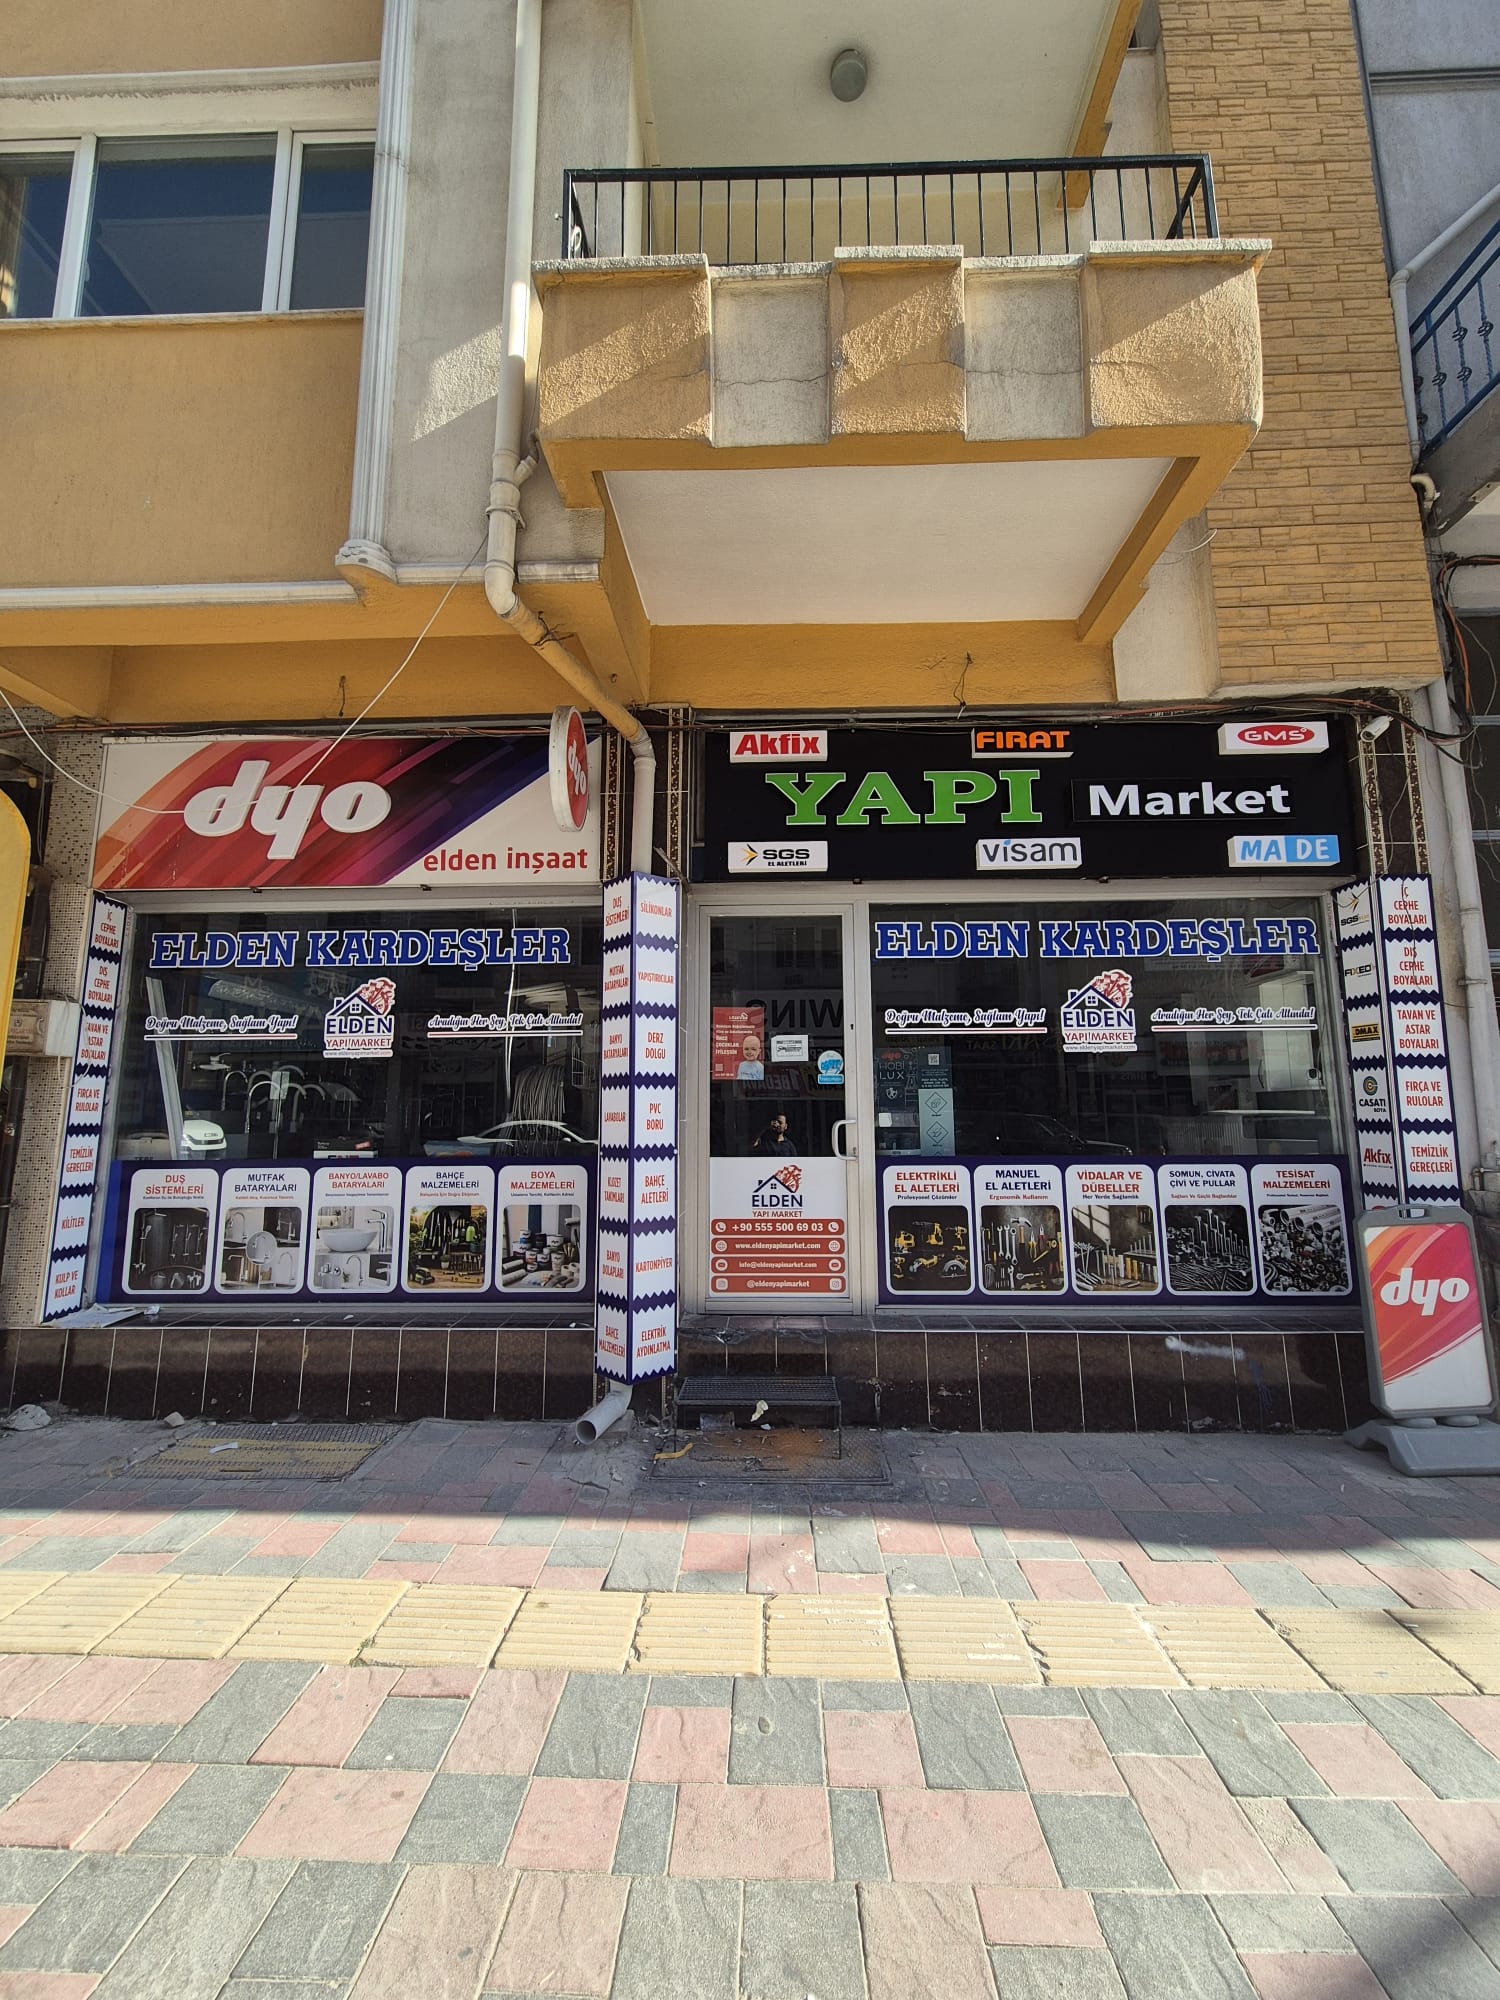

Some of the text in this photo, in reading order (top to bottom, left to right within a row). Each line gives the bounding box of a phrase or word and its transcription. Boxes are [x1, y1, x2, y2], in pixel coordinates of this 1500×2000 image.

[976, 730, 1071, 749] FIRAT
[1243, 729, 1306, 741] GMS
[734, 733, 821, 756] Akfix
[568, 740, 587, 795] dyo
[765, 769, 1291, 826] YAPI Market
[183, 759, 392, 860] dyo
[763, 849, 810, 860] SGS
[982, 839, 1078, 865] visam
[423, 847, 588, 874] elden inşaat
[640, 901, 672, 918] SİLİKONLAR
[1393, 901, 1419, 911] CEPHE
[605, 906, 630, 927] SİSTEMLERİ
[1340, 914, 1359, 926] SGS
[1387, 914, 1427, 925] BOYALARI
[100, 922, 116, 935] CEPHE
[94, 933, 119, 949] BOYALARI
[875, 917, 1320, 962] ELDEN KARDEŞLER
[150, 927, 571, 971] ELDEN KARDEŞLER
[1404, 946, 1417, 958] DIŞ
[99, 965, 109, 977] DIŞ
[1399, 960, 1425, 971] CEPHE
[94, 978, 111, 990] CEPHE
[637, 971, 674, 985] YAPIŞTIRICILAR
[1393, 974, 1433, 986] BOYALARI
[88, 990, 112, 1003] BOYALARI
[885, 1009, 920, 1028] Doğru
[973, 1008, 1014, 1027] Sağlam
[1014, 1008, 1046, 1027] Yapı!
[1063, 1010, 1133, 1027] ELDEN
[1151, 1006, 1317, 1025] Aradığın Her Şey, Tek Çatı Altında!
[1397, 1009, 1436, 1020] TAVAN VE
[145, 1016, 178, 1033] Doğru
[229, 1015, 267, 1033] Sağlam
[267, 1014, 299, 1033] Yapı!
[326, 1017, 392, 1034] ELDEN
[428, 1013, 583, 1031] Aradığın Her Şey, Tek Çatı Altında!
[87, 1023, 109, 1034] AVAN VE
[1355, 1025, 1379, 1036] DMAX
[1405, 1023, 1431, 1035] ASTAR
[647, 1032, 664, 1044] DERZ
[1065, 1032, 1133, 1040] YAPI MARKET
[326, 1038, 391, 1047] YAPI MARKET
[1399, 1038, 1439, 1049] BOYALARI
[645, 1047, 666, 1060] DOLGU
[879, 1071, 905, 1080] LUX
[1405, 1081, 1442, 1094] FIRÇA VE
[77, 1088, 100, 1100] FIRÇA VE
[75, 1102, 99, 1112] RULOLAR
[1358, 1098, 1386, 1107] CASATI
[1406, 1095, 1444, 1107] RULOLAR
[649, 1103, 661, 1115] PVC
[646, 1119, 664, 1130] BORU
[70, 1147, 93, 1159] TEMİZLİK
[1363, 1148, 1392, 1165] Akfix
[1411, 1144, 1449, 1158] TEMİZLİK
[66, 1159, 94, 1173] GEREÇLERİ
[1409, 1159, 1453, 1174] GEREÇLERİ
[165, 1174, 186, 1185] DUŞ
[247, 1174, 285, 1182] MUTFAK
[328, 1172, 389, 1180] BANYO/LAVABO
[436, 1172, 465, 1180] BAHÇE
[896, 1170, 957, 1180] ELEKTRİKLİ
[995, 1170, 1040, 1178] MANUEL
[1077, 1170, 1143, 1180] VİDALAR VE
[1206, 1169, 1236, 1178] CİVATA
[1276, 1169, 1315, 1178] TESİSAT
[234, 1184, 297, 1192] BATARYALARI
[420, 1180, 480, 1188] MALZEMELERİ
[510, 1180, 575, 1189] MALZEMELERİ
[645, 1175, 665, 1189] BAHÇE
[894, 1182, 960, 1192] EL ALETLERİ
[986, 1180, 1051, 1190] EL ALETLERİ
[1082, 1182, 1140, 1192] DÜBELLER
[1170, 1179, 1186, 1188] ÇİVİ
[1263, 1179, 1330, 1188] MALZEMELERİ
[145, 1184, 204, 1195] SİSTEMLERİ
[641, 1188, 669, 1205] ALETLERİ
[752, 1194, 803, 1207] ELDEN
[61, 1214, 85, 1230] KİLİTLER
[732, 1223, 823, 1231] +90 555 500 69 03
[635, 1256, 673, 1273] KARTONPİYER
[55, 1270, 78, 1284] KULP VE
[747, 1280, 810, 1288] @eldenyapimarket
[54, 1285, 76, 1299] KOLLAR
[1380, 1267, 1470, 1316] dyo
[641, 1324, 667, 1341] ELEKTRİK
[636, 1340, 671, 1358] AYDINLATMA
